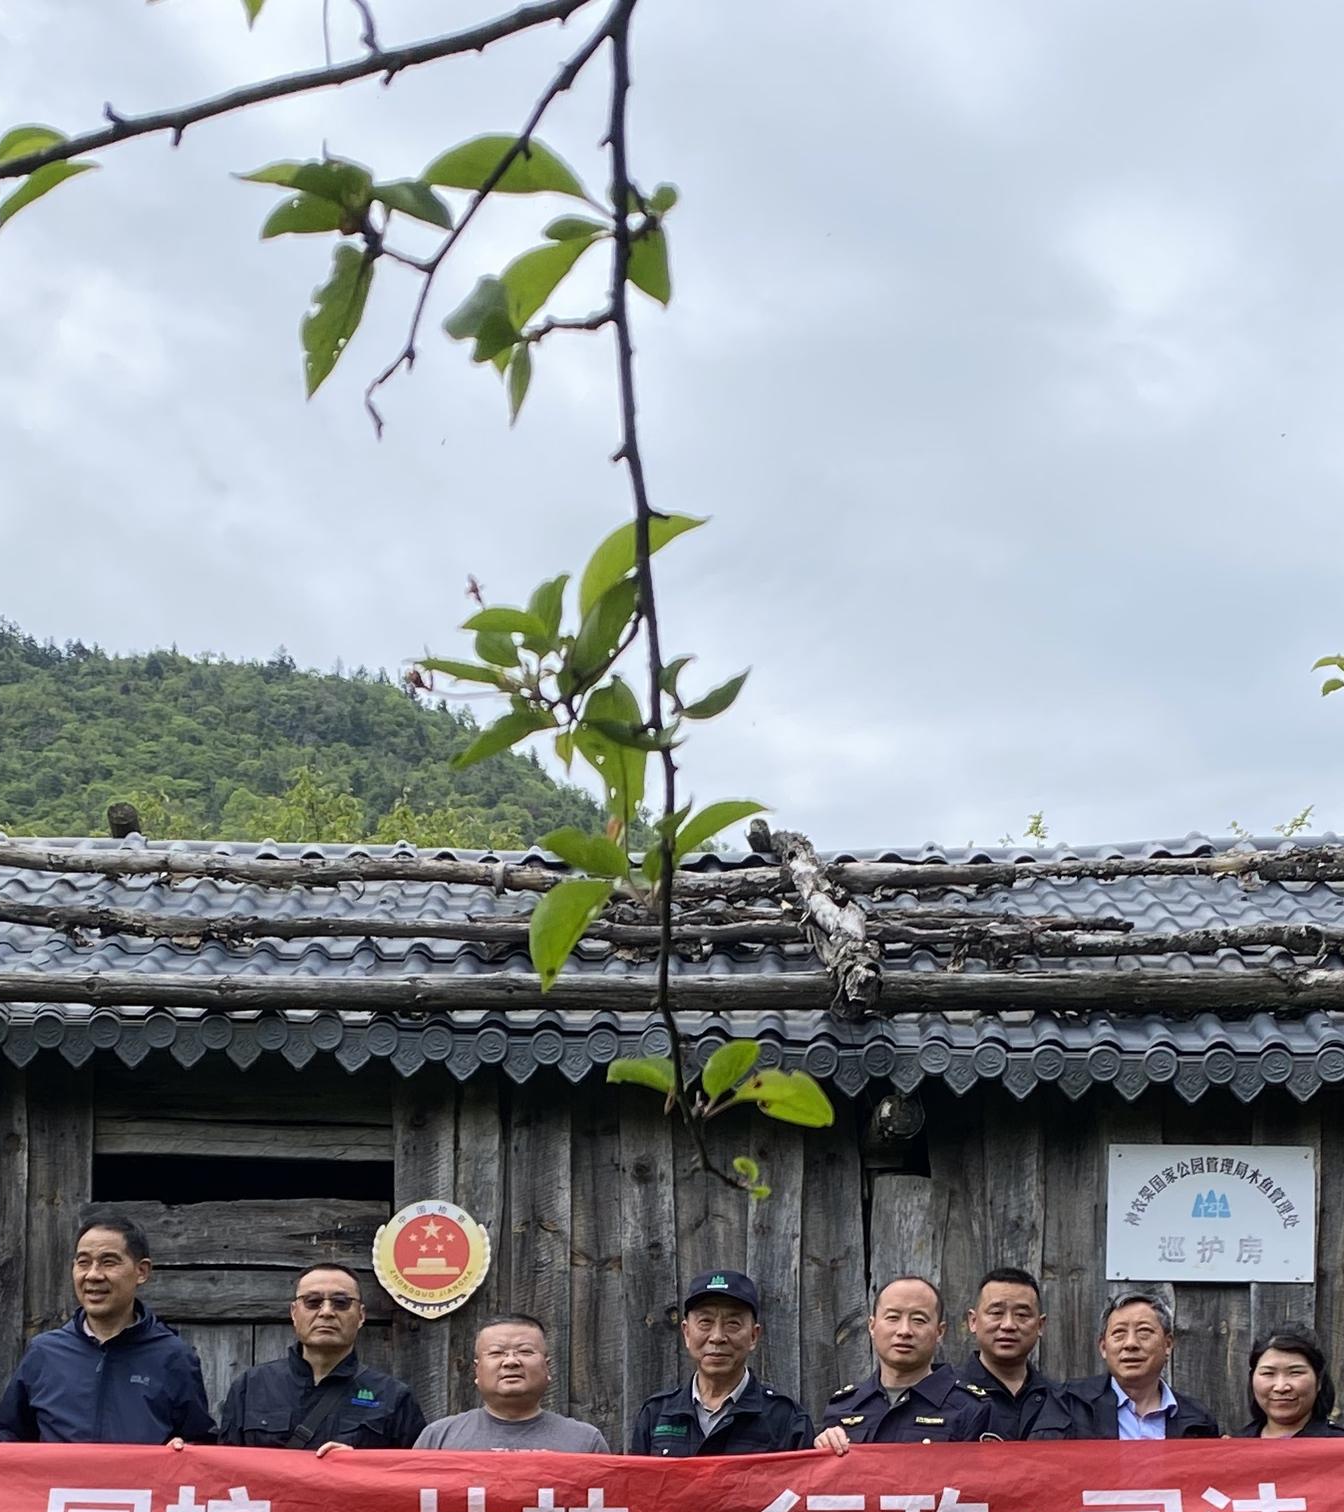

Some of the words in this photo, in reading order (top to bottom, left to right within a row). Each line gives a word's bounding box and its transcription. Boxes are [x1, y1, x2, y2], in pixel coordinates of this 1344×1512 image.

[1158, 1235, 1264, 1265] 巡护房
[390, 1270, 435, 1298] ZHONGGUO
[439, 1271, 473, 1297] JIANCHA
